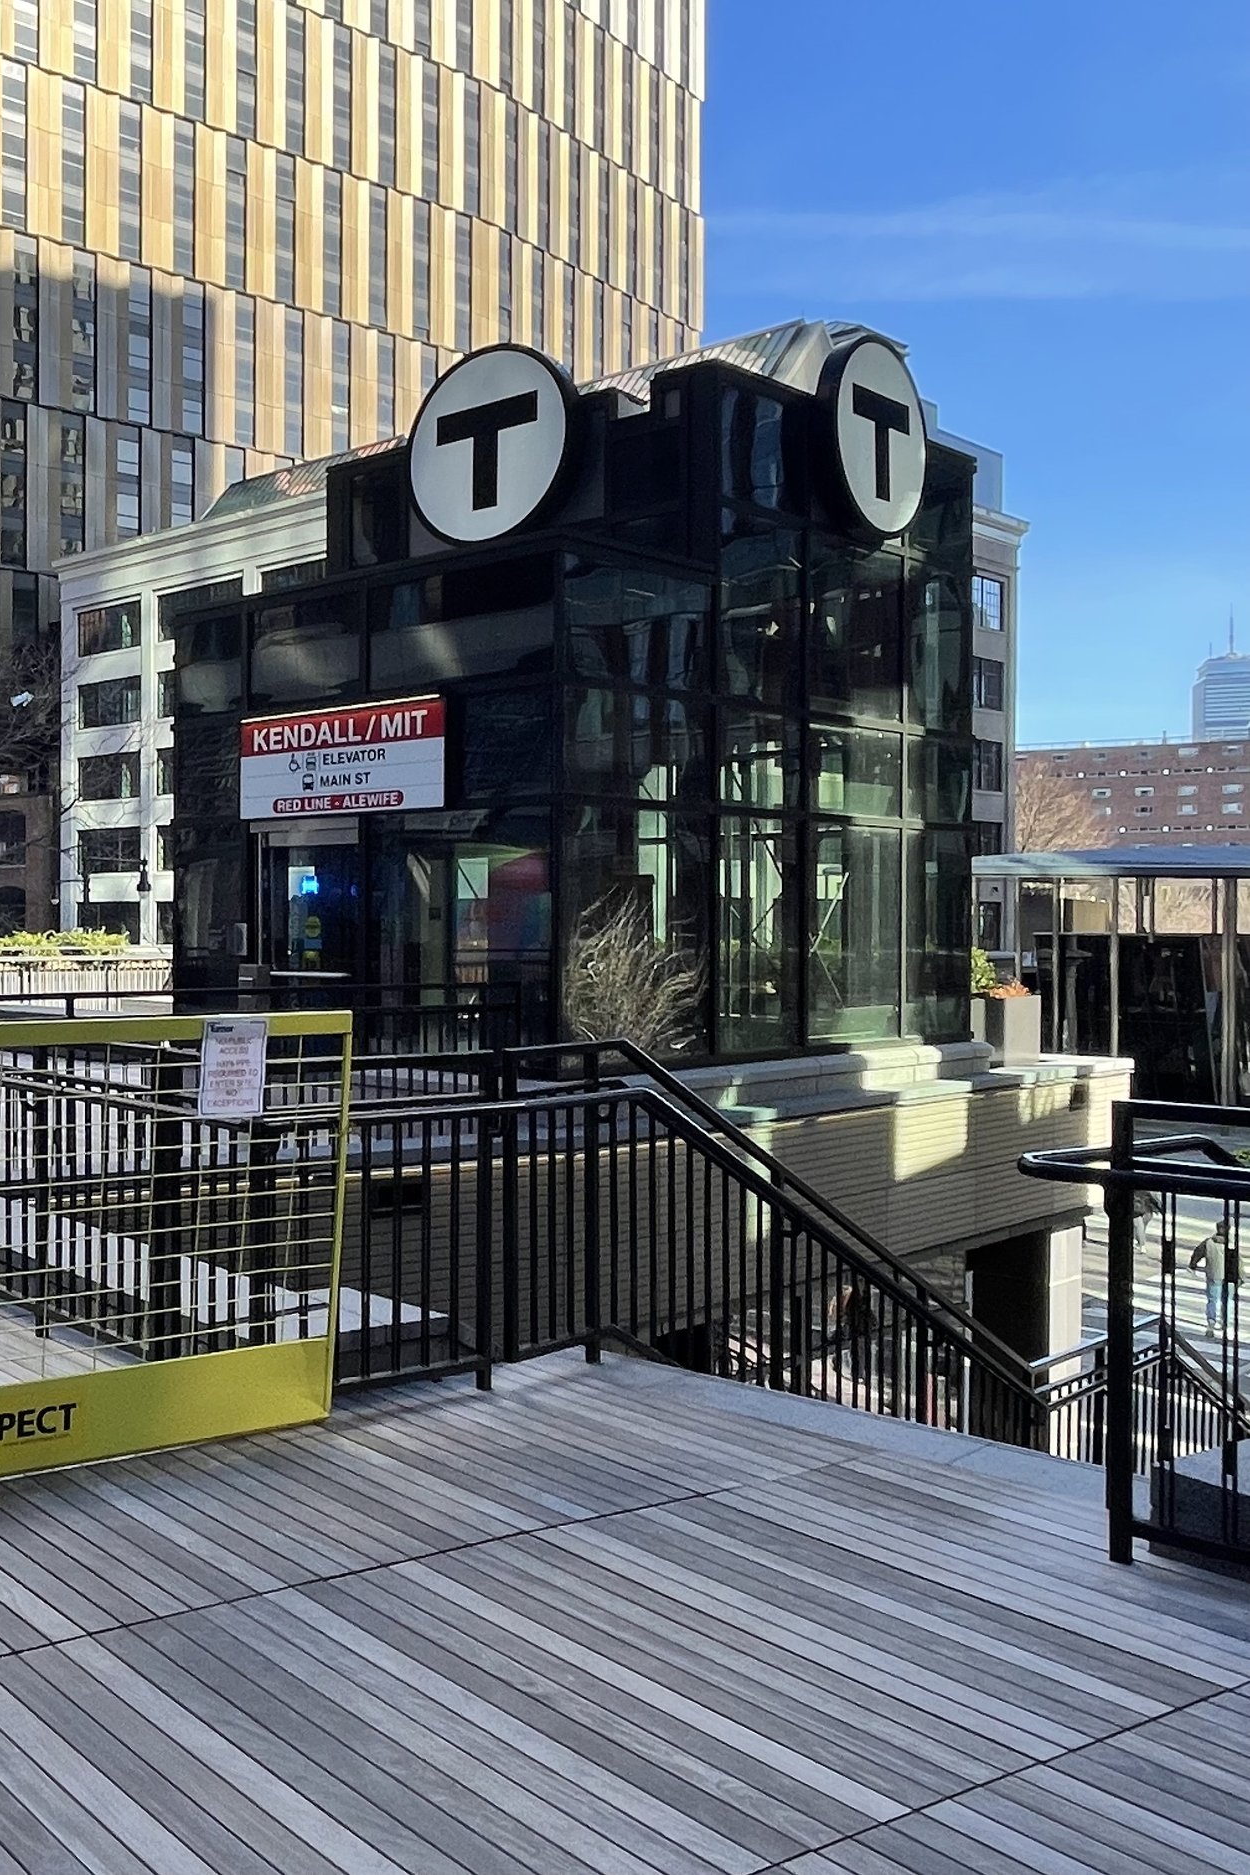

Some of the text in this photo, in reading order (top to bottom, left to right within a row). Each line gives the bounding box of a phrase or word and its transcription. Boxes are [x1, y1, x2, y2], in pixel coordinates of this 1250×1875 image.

[436, 389, 538, 512] T
[852, 383, 910, 502] T
[253, 718, 362, 752] KENDALL
[381, 709, 428, 739] MIT
[322, 748, 386, 765] ELEVATOR
[320, 772, 371, 788] MAIN ST
[276, 791, 399, 812] RED LINE ALEWIFE
